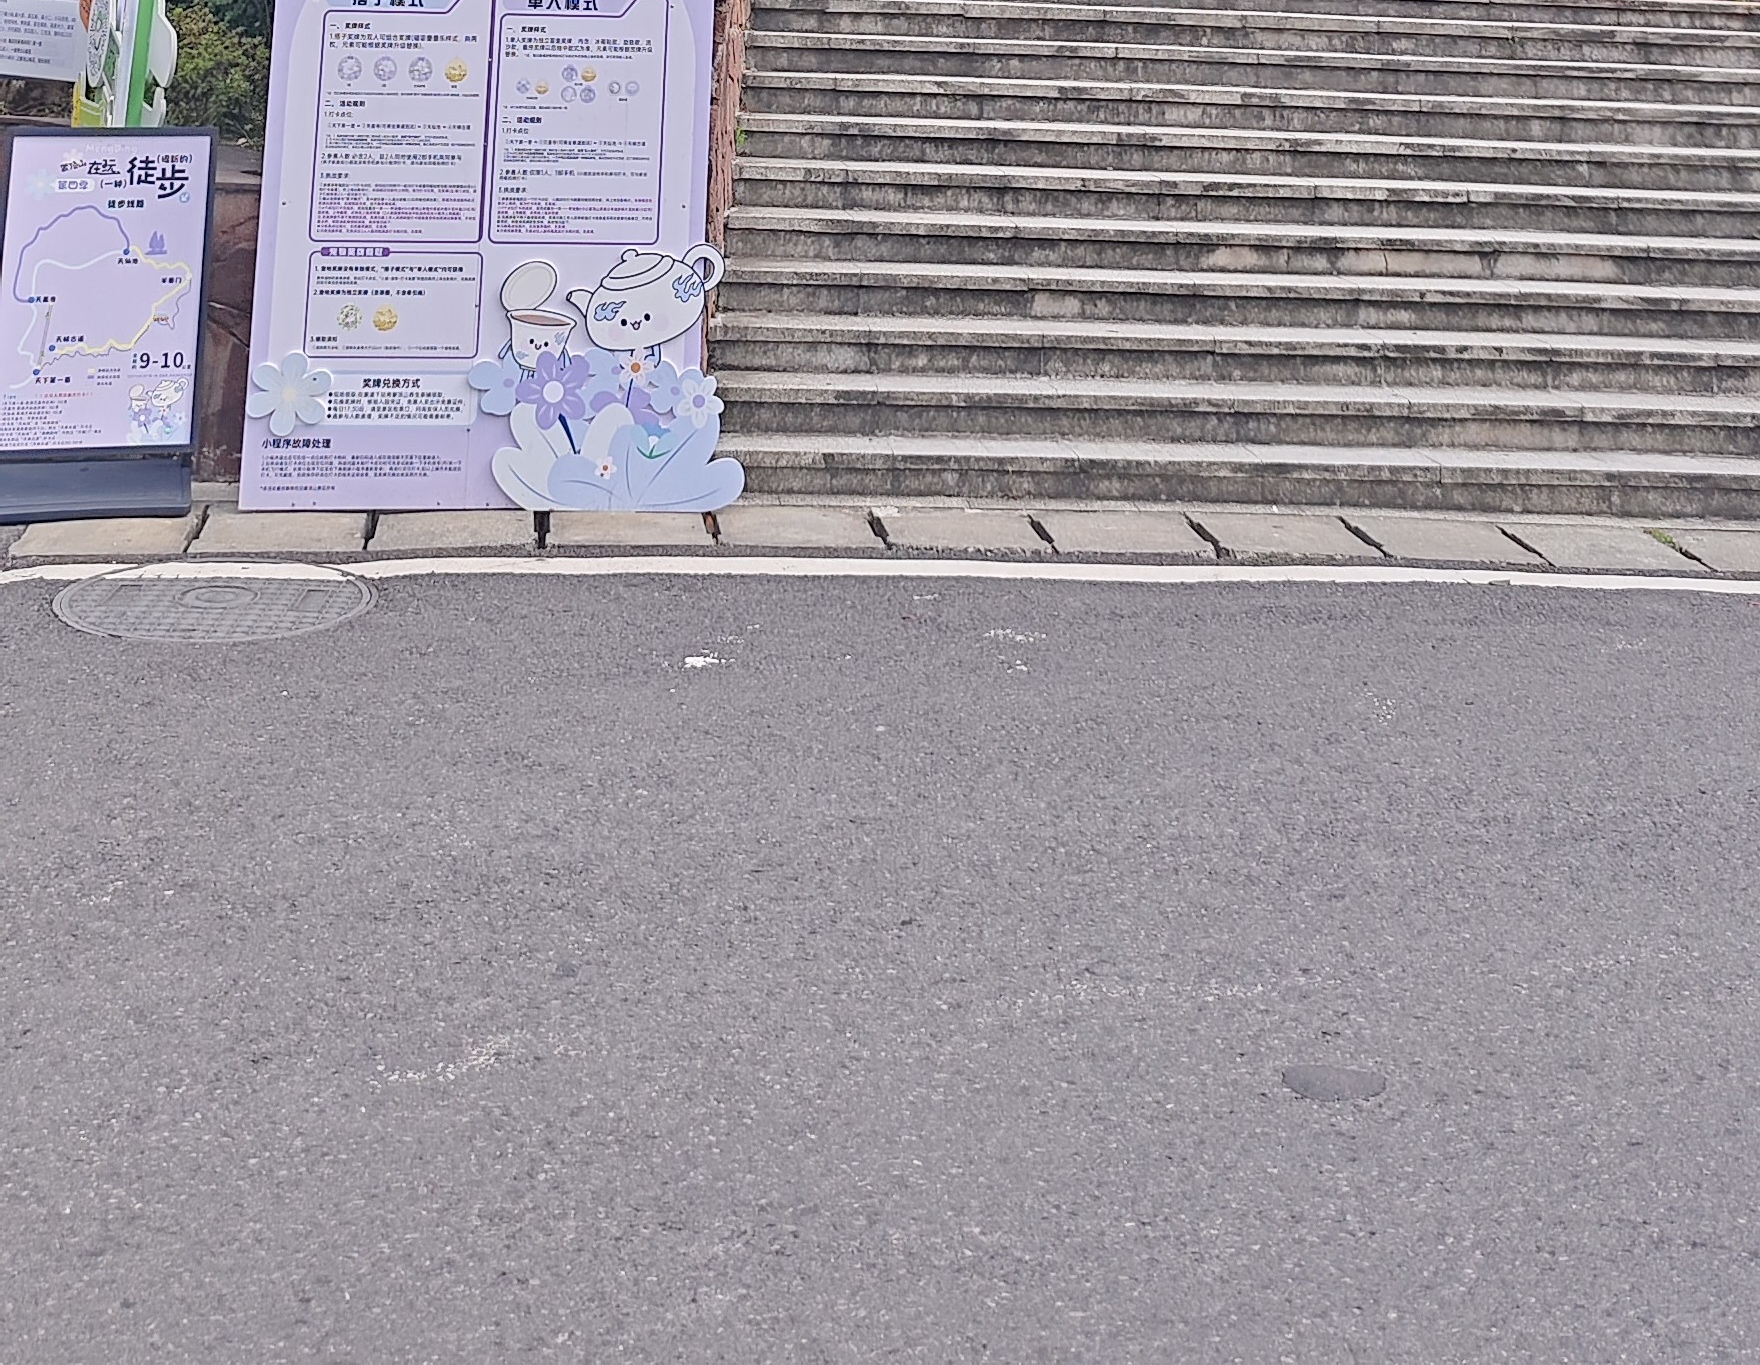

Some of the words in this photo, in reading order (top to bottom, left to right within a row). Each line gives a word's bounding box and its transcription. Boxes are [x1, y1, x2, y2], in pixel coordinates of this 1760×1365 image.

[126, 155, 189, 199] 徒步
[139, 351, 184, 369] 9-10
[362, 378, 421, 389] 奖牌兑换方式
[261, 438, 332, 449] 小程序故障处理
